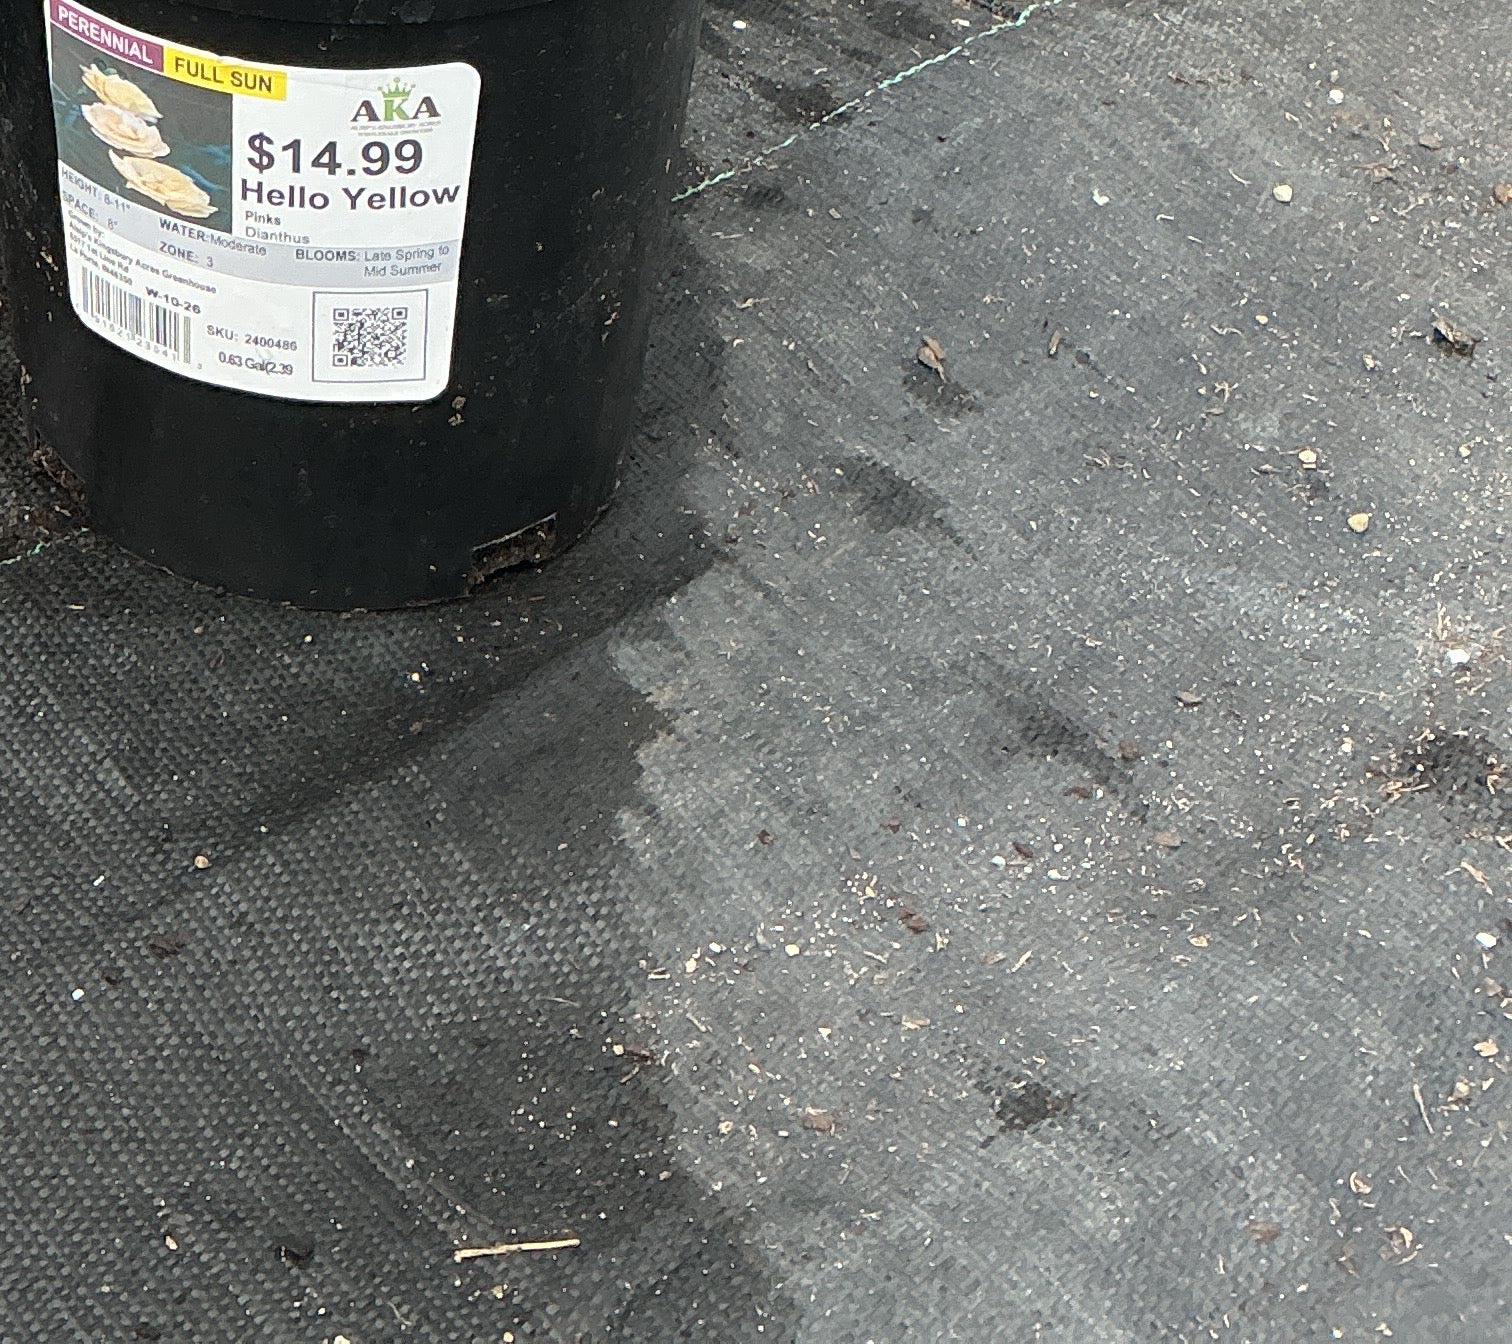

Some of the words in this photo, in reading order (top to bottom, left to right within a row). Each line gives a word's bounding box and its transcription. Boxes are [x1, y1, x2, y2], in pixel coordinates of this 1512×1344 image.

[58, 4, 154, 65] PERENNIAL
[174, 56, 224, 84] FULL
[230, 70, 273, 94] SUN
[350, 95, 442, 123] AKA
[247, 132, 424, 176] $14.99
[61, 190, 99, 221] SPACE:
[241, 178, 331, 210] Hello
[342, 184, 461, 211] Yellow
[245, 210, 282, 226] Pinks
[159, 217, 210, 243] WATER:
[210, 234, 268, 256] Moderate
[245, 226, 311, 244] Dianthus
[159, 241, 200, 264] ZONE:
[206, 256, 214, 268] 3
[295, 248, 361, 263] BLOOMS:
[364, 250, 392, 262] Late
[395, 248, 436, 263] Spring
[438, 244, 450, 257] to
[136, 258, 160, 275] Acres
[161, 268, 217, 294] Greenhouse
[364, 265, 387, 278] Mid
[390, 262, 442, 276] Summer
[145, 285, 202, 314] W-10-26
[206, 324, 239, 342] SKU:
[244, 333, 298, 352] 2400486
[218, 350, 243, 368] 0.63
